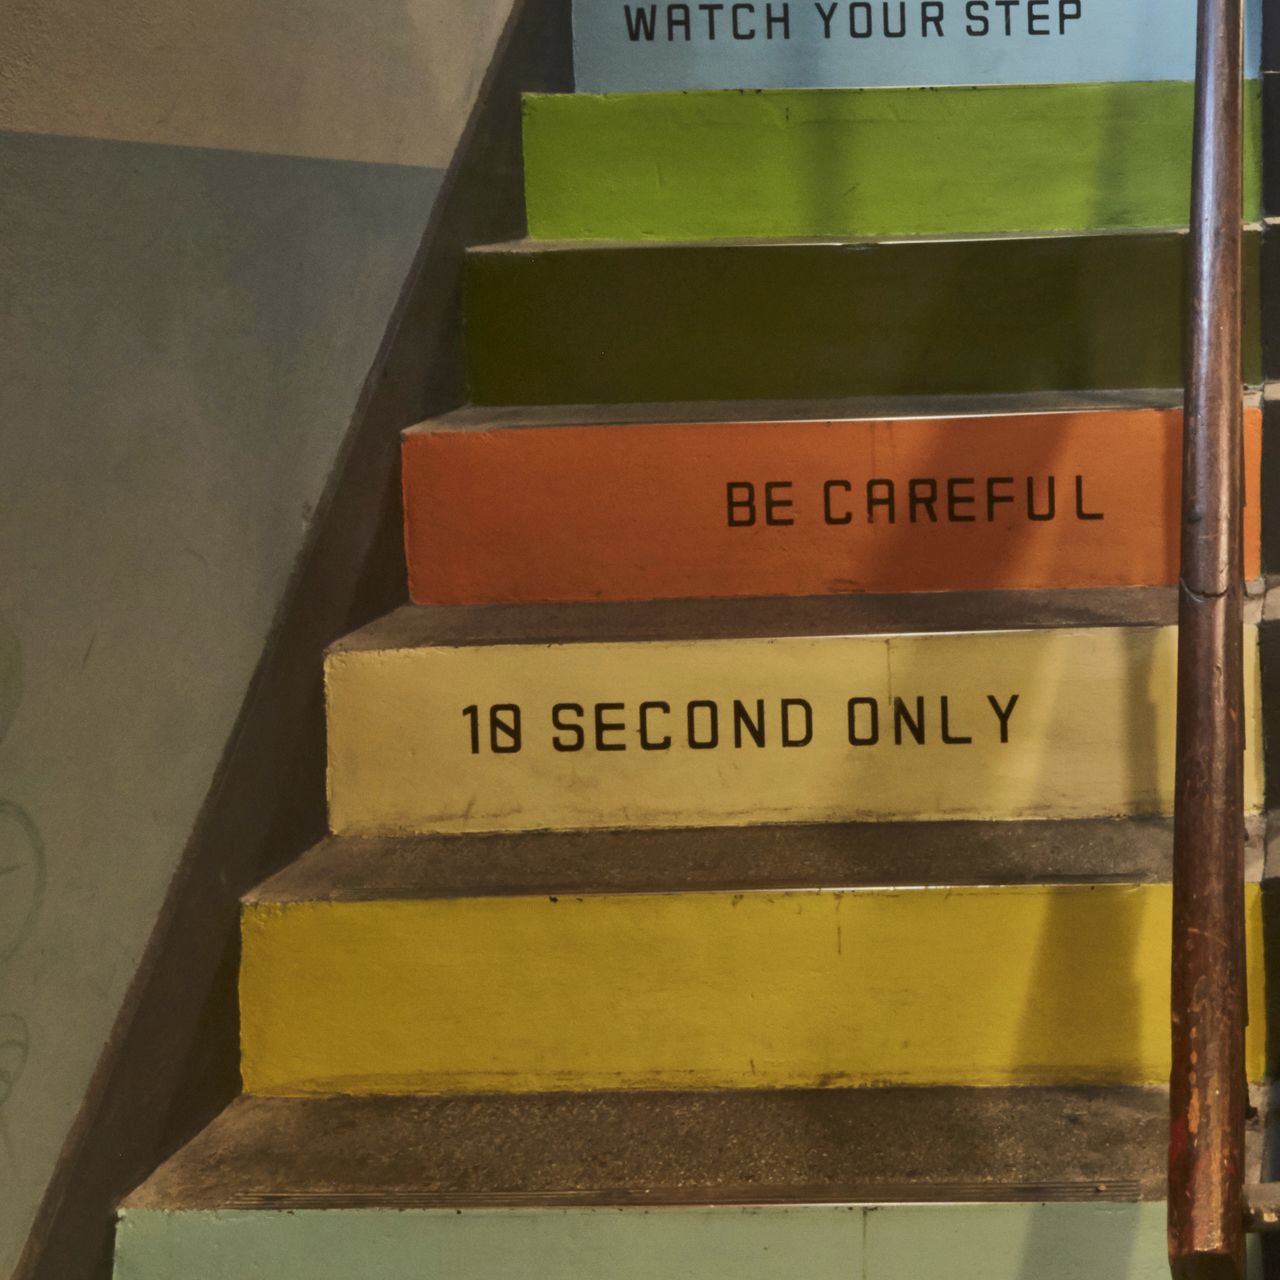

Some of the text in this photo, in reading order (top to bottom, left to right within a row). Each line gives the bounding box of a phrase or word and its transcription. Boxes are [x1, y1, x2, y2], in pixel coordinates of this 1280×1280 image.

[624, 0, 1083, 40] WATCH YOUR STEP
[725, 475, 1104, 526] BE CAREFUL
[462, 694, 1020, 754] 10 SECOND ONLY
